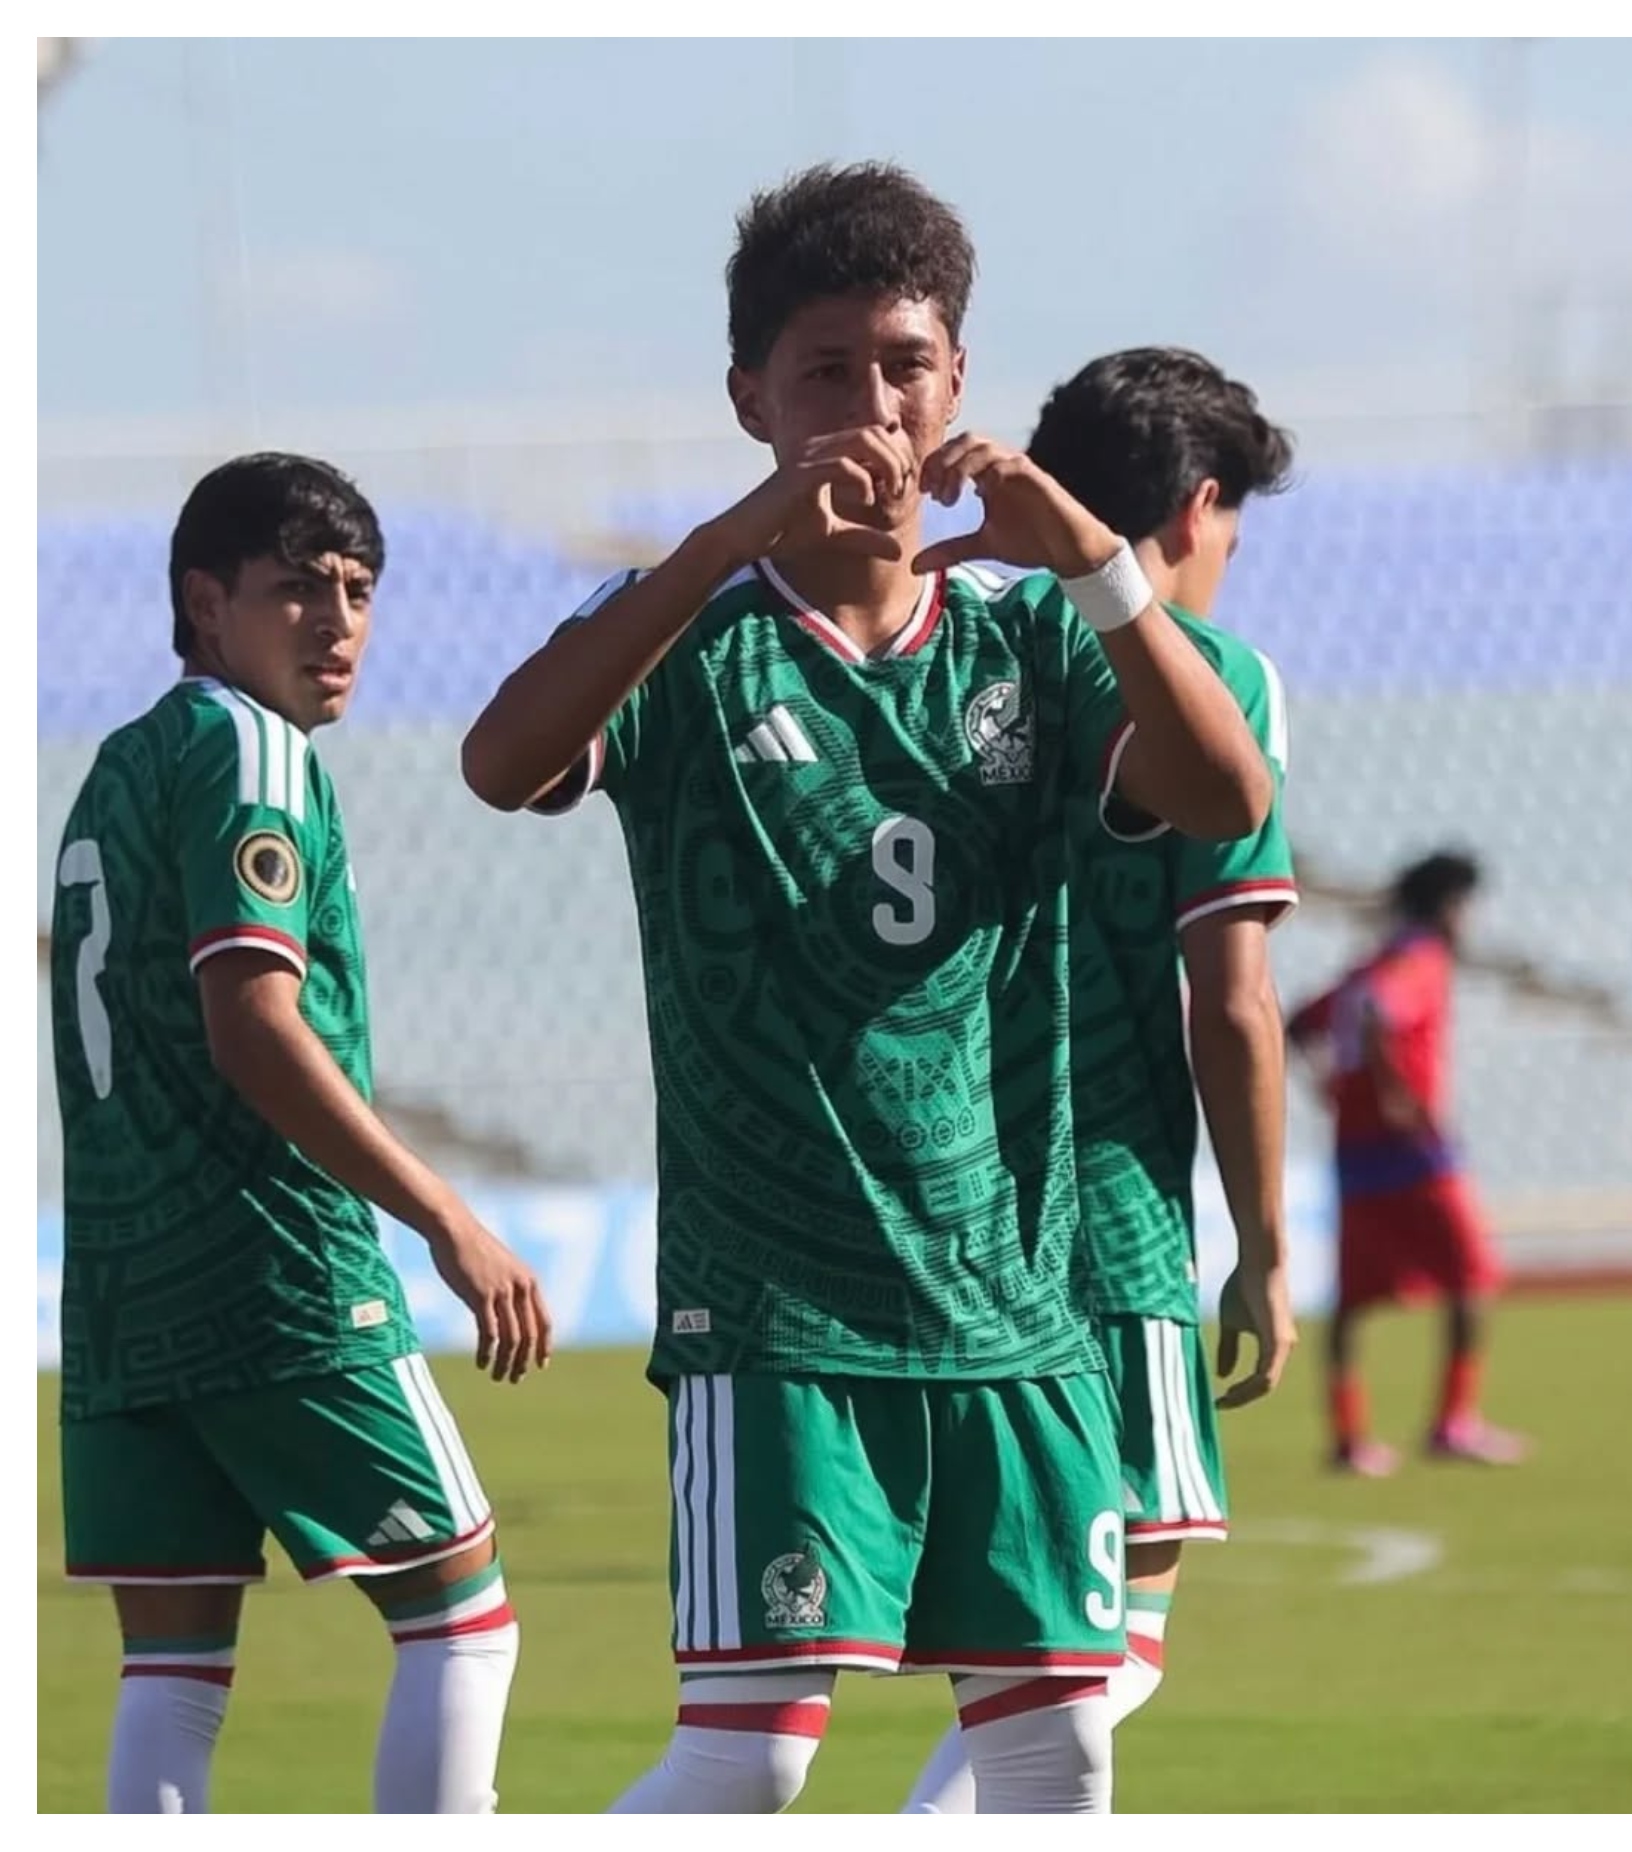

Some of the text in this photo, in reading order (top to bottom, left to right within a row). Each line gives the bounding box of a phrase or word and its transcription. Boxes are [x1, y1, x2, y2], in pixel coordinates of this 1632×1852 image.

[872, 815, 936, 945] 9
[60, 838, 113, 1100] 7
[1085, 1509, 1123, 1631] 9
